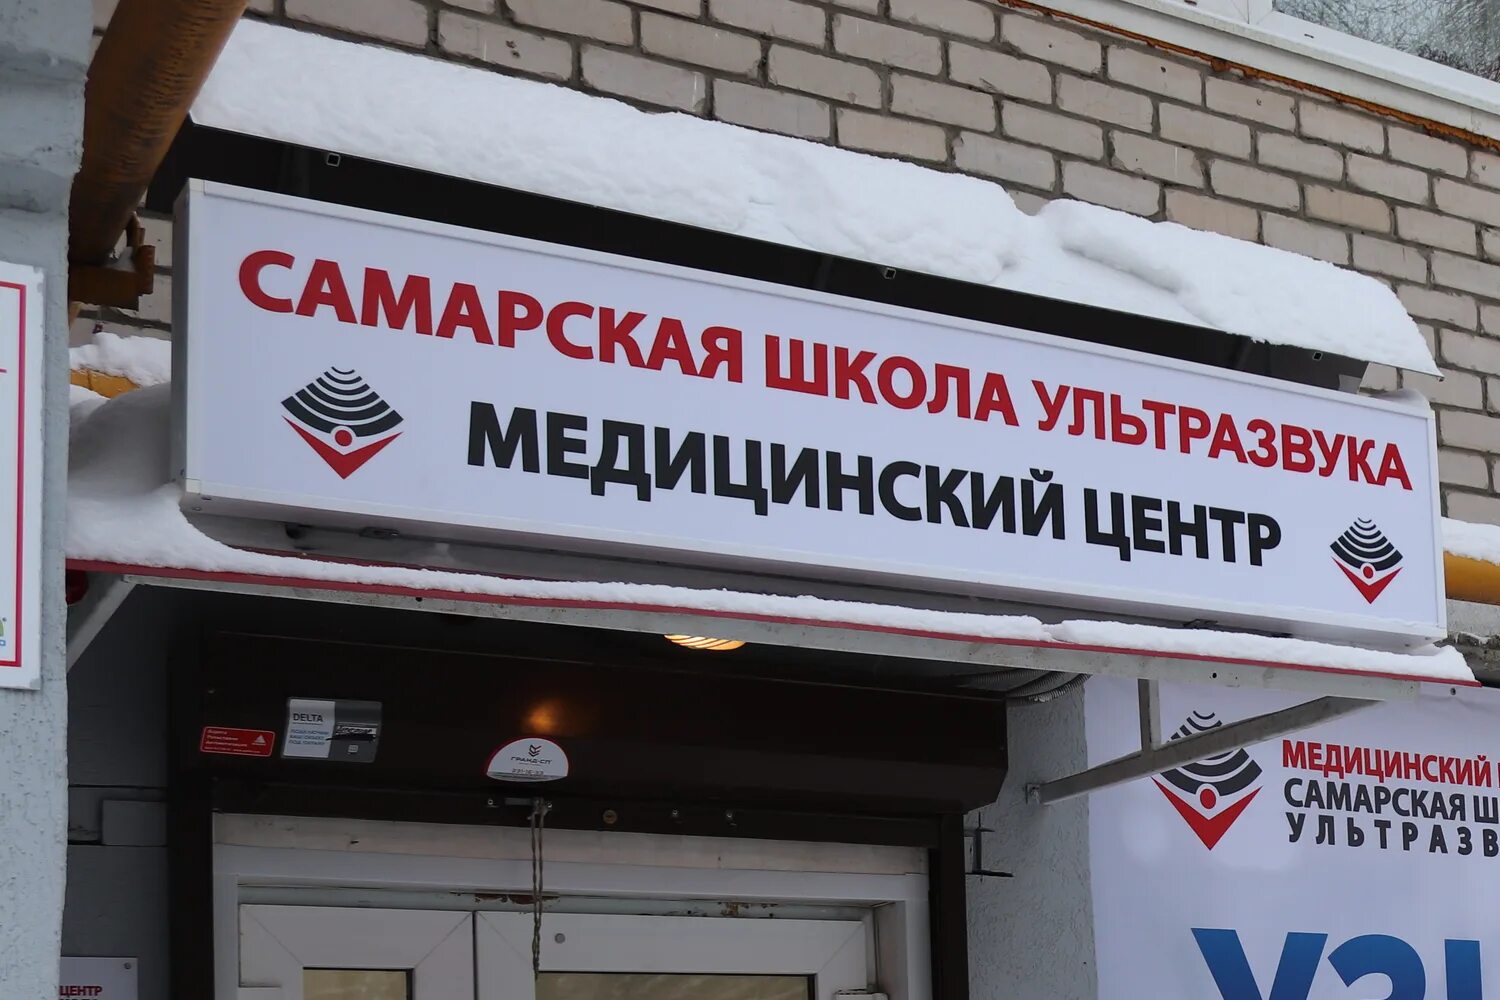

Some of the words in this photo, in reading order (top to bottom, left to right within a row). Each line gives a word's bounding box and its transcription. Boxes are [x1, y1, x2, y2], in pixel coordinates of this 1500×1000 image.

[238, 249, 743, 384] САМАРСКАЯ
[764, 334, 1019, 427] ШКОЛА
[1032, 379, 1413, 491] УЛЬТРАЗВУКА
[467, 400, 1066, 541] МЕДИЦИНСКИЙ
[1083, 487, 1282, 567] ЦЕНТР
[293, 713, 324, 723] DELTA
[1282, 739, 1491, 788] МЕДИЦИНСКИЙ
[1283, 777, 1467, 822] САМАРСКАЯ
